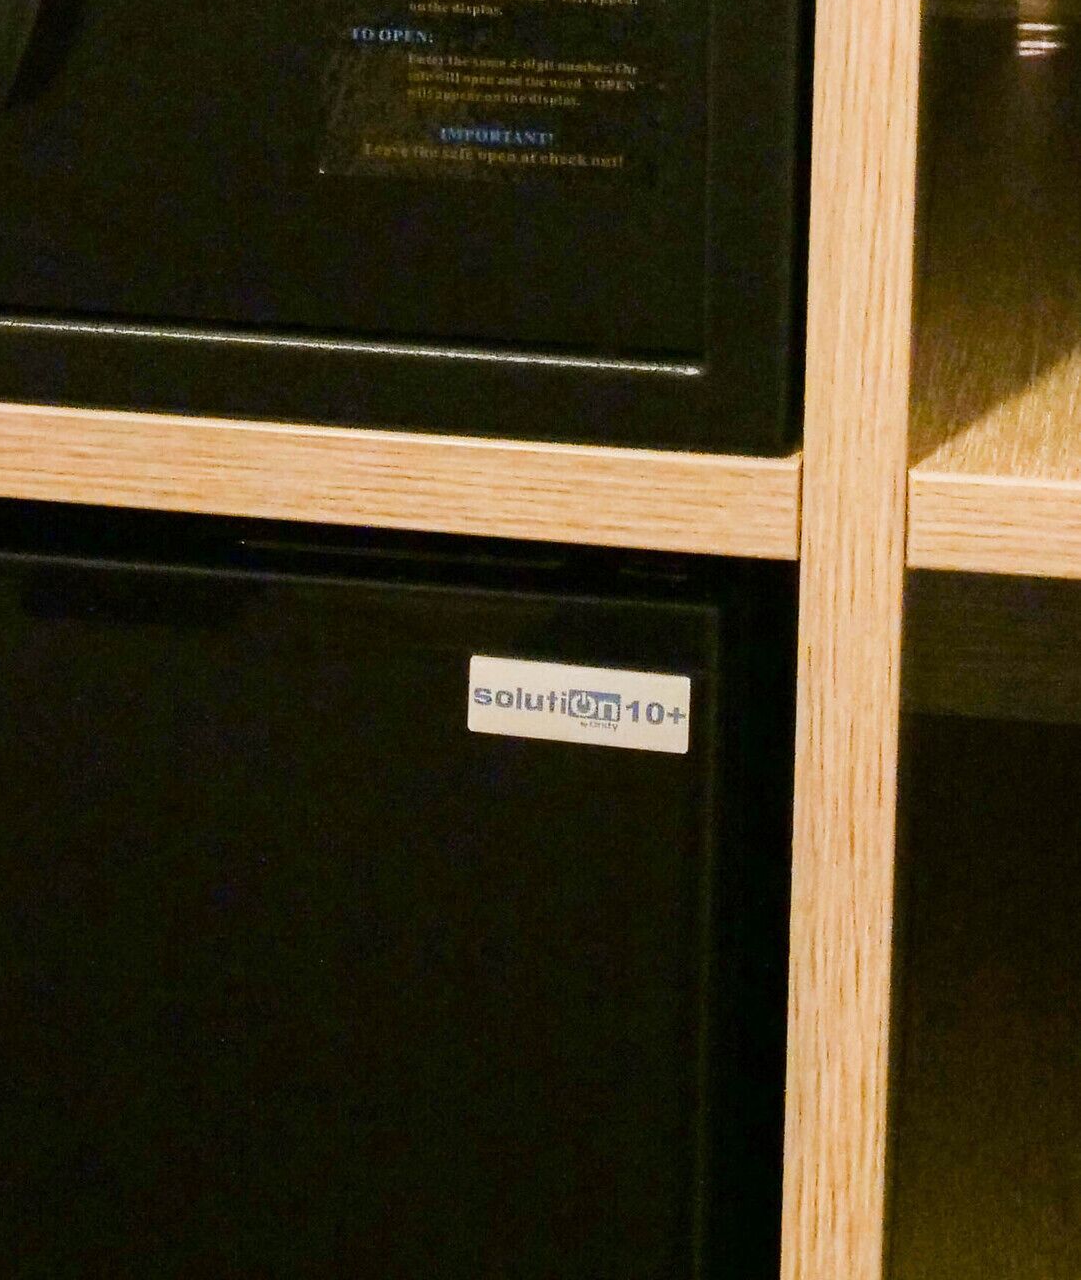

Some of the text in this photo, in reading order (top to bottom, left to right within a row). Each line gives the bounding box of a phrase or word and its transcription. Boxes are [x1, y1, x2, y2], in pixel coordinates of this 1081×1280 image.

[427, 2, 449, 13] the
[352, 28, 375, 41] TO
[625, 699, 687, 726] 10+
